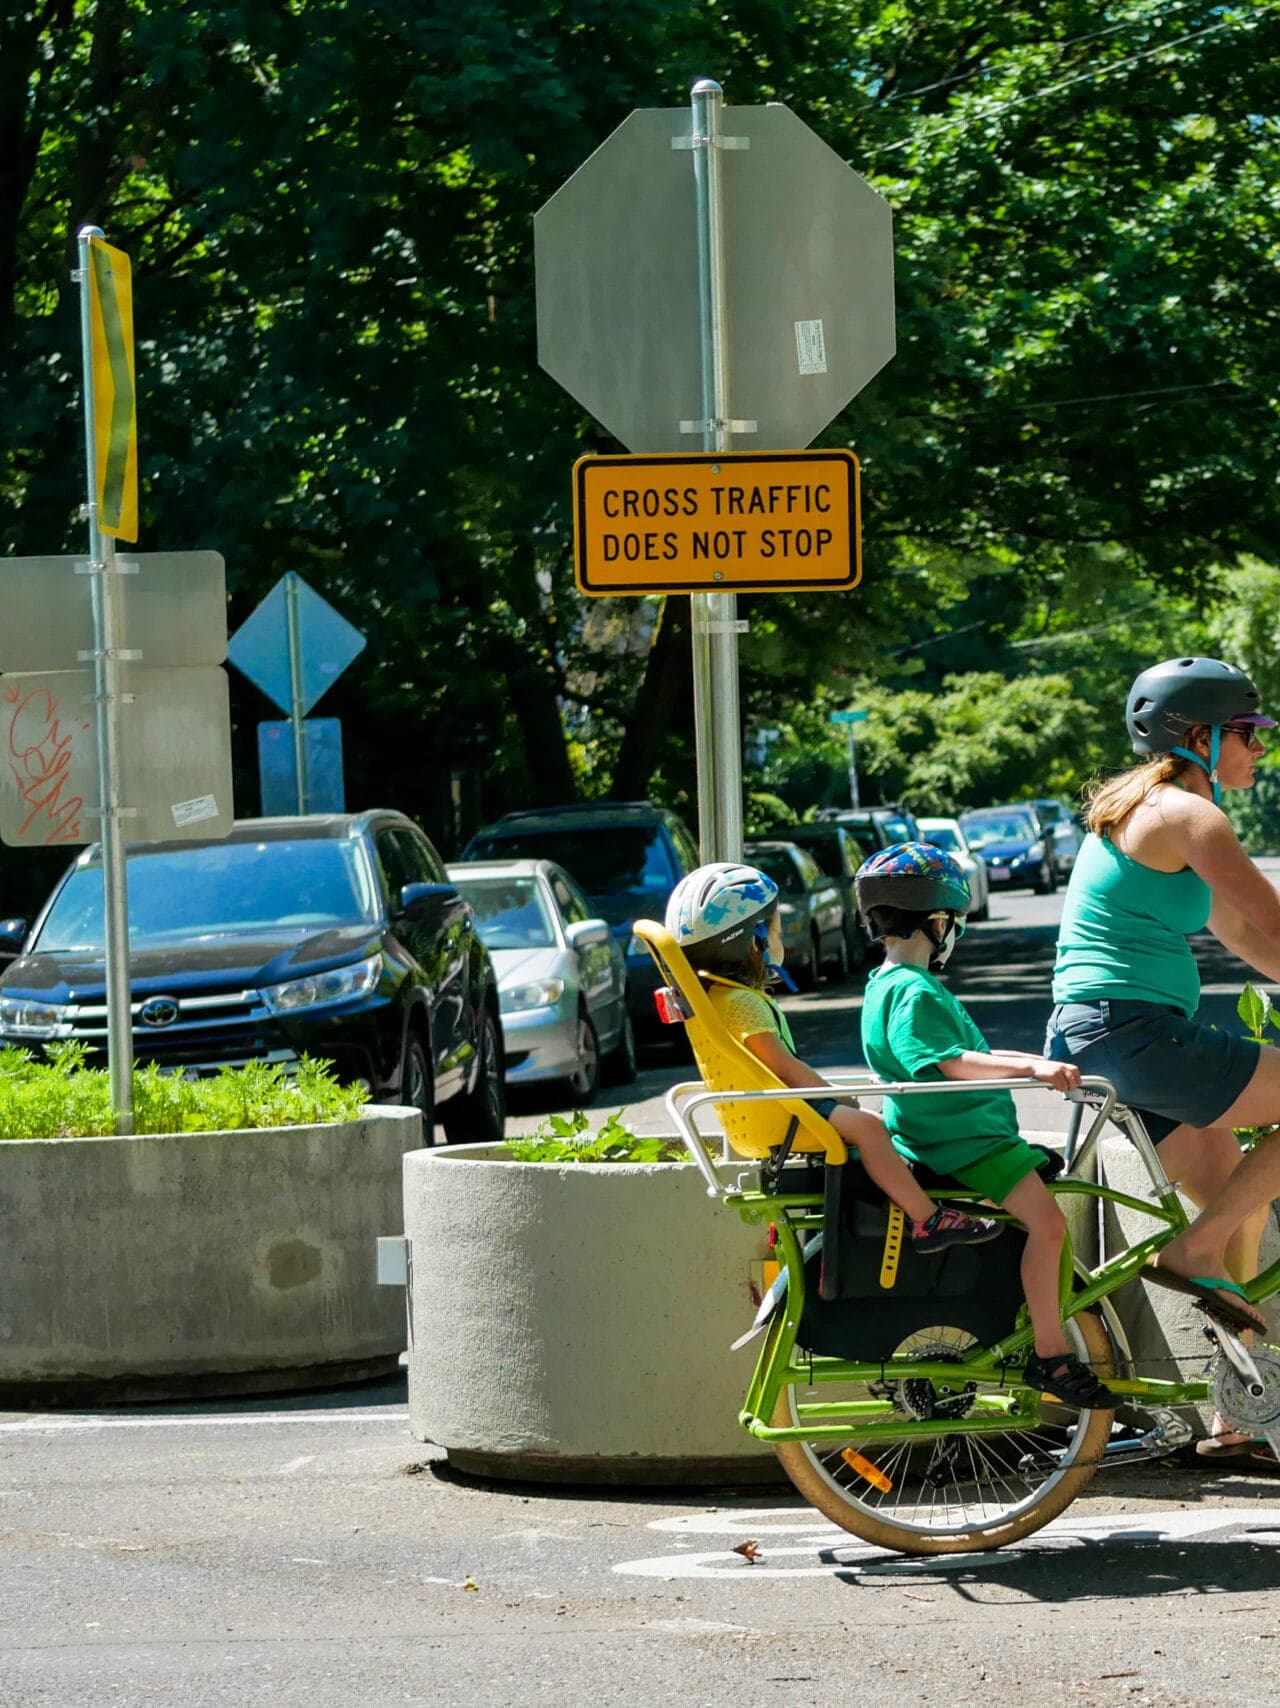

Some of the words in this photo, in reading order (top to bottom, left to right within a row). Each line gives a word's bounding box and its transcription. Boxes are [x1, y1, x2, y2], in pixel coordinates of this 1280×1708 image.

[603, 487, 698, 518] CROSS
[711, 484, 831, 515] TRAFFIC
[603, 532, 678, 562] DOES
[693, 530, 747, 559] NOT
[760, 528, 833, 558] STOP
